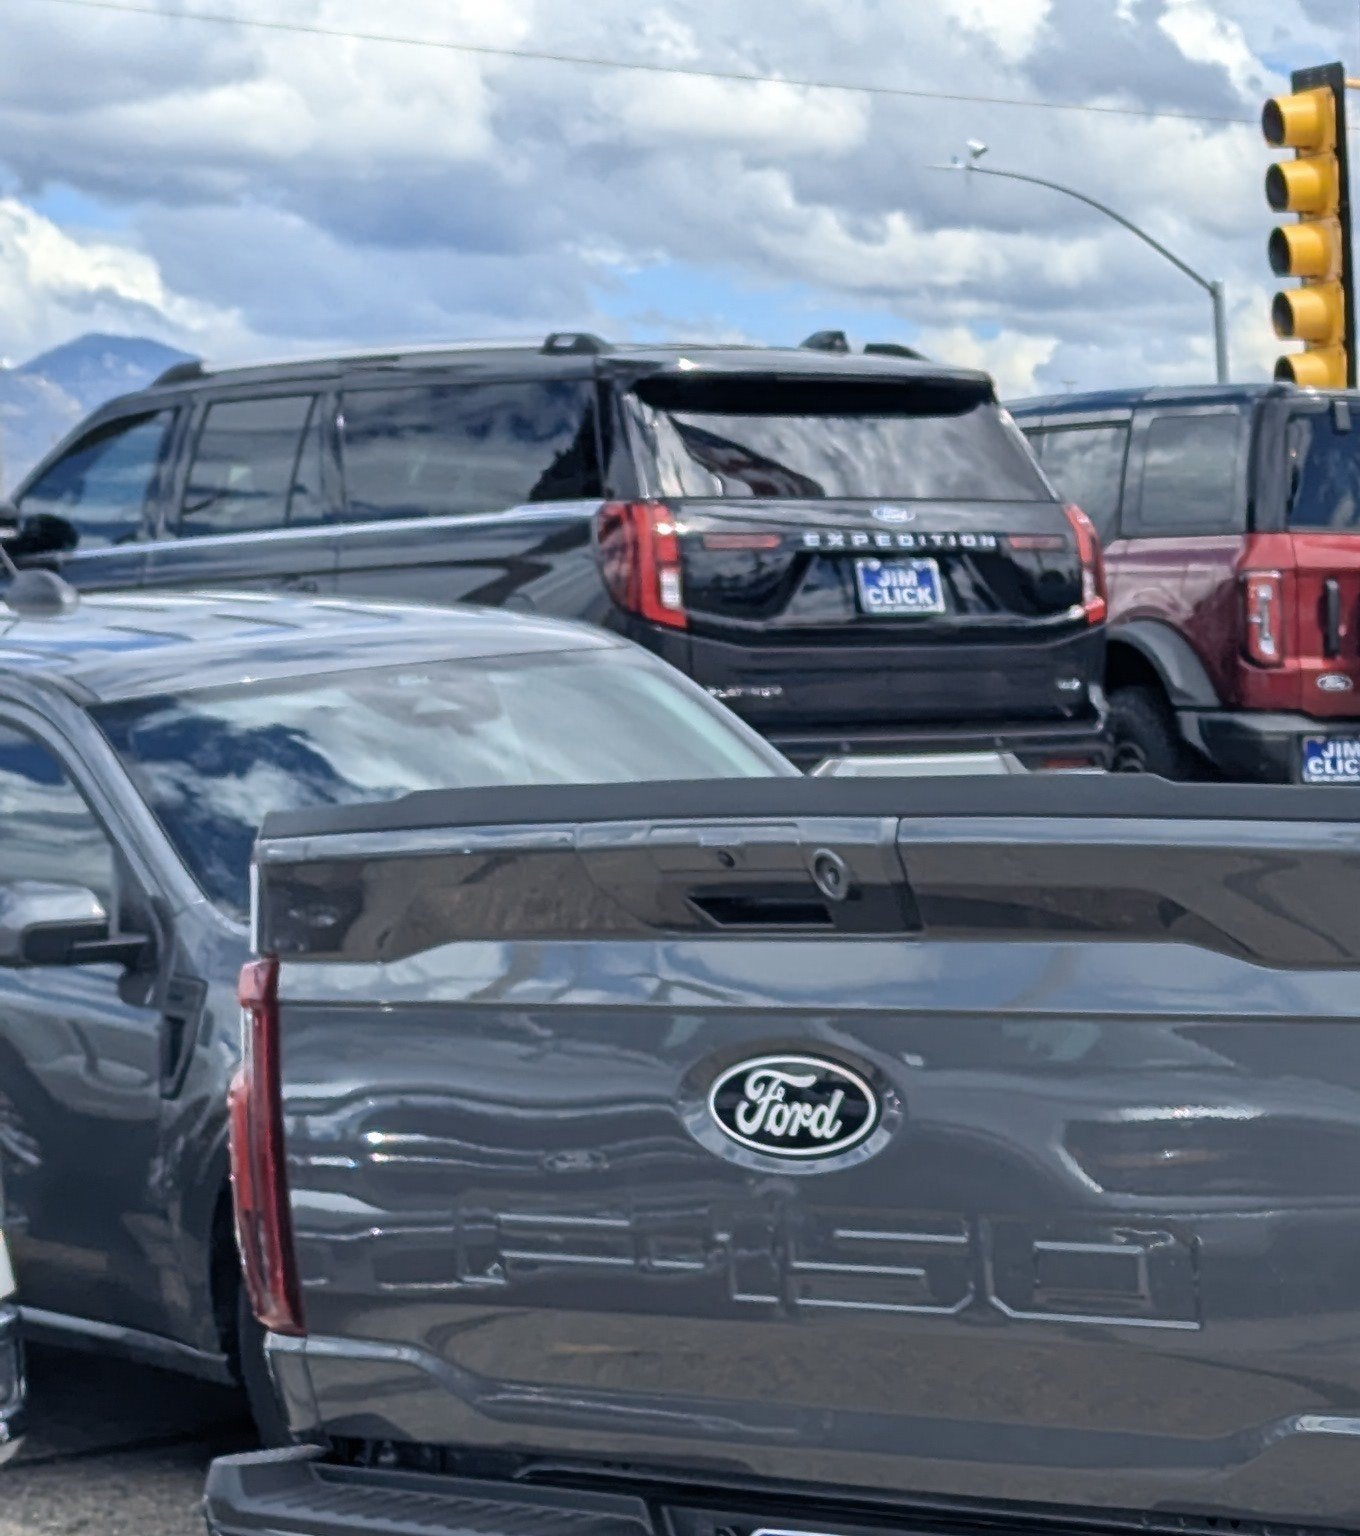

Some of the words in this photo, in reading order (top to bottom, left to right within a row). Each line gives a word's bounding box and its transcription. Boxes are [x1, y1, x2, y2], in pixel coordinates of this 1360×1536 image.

[803, 531, 997, 548] EXPEDITION
[878, 569, 918, 587] JIM
[868, 586, 936, 606] CLICK
[735, 1069, 845, 1139] Ford
